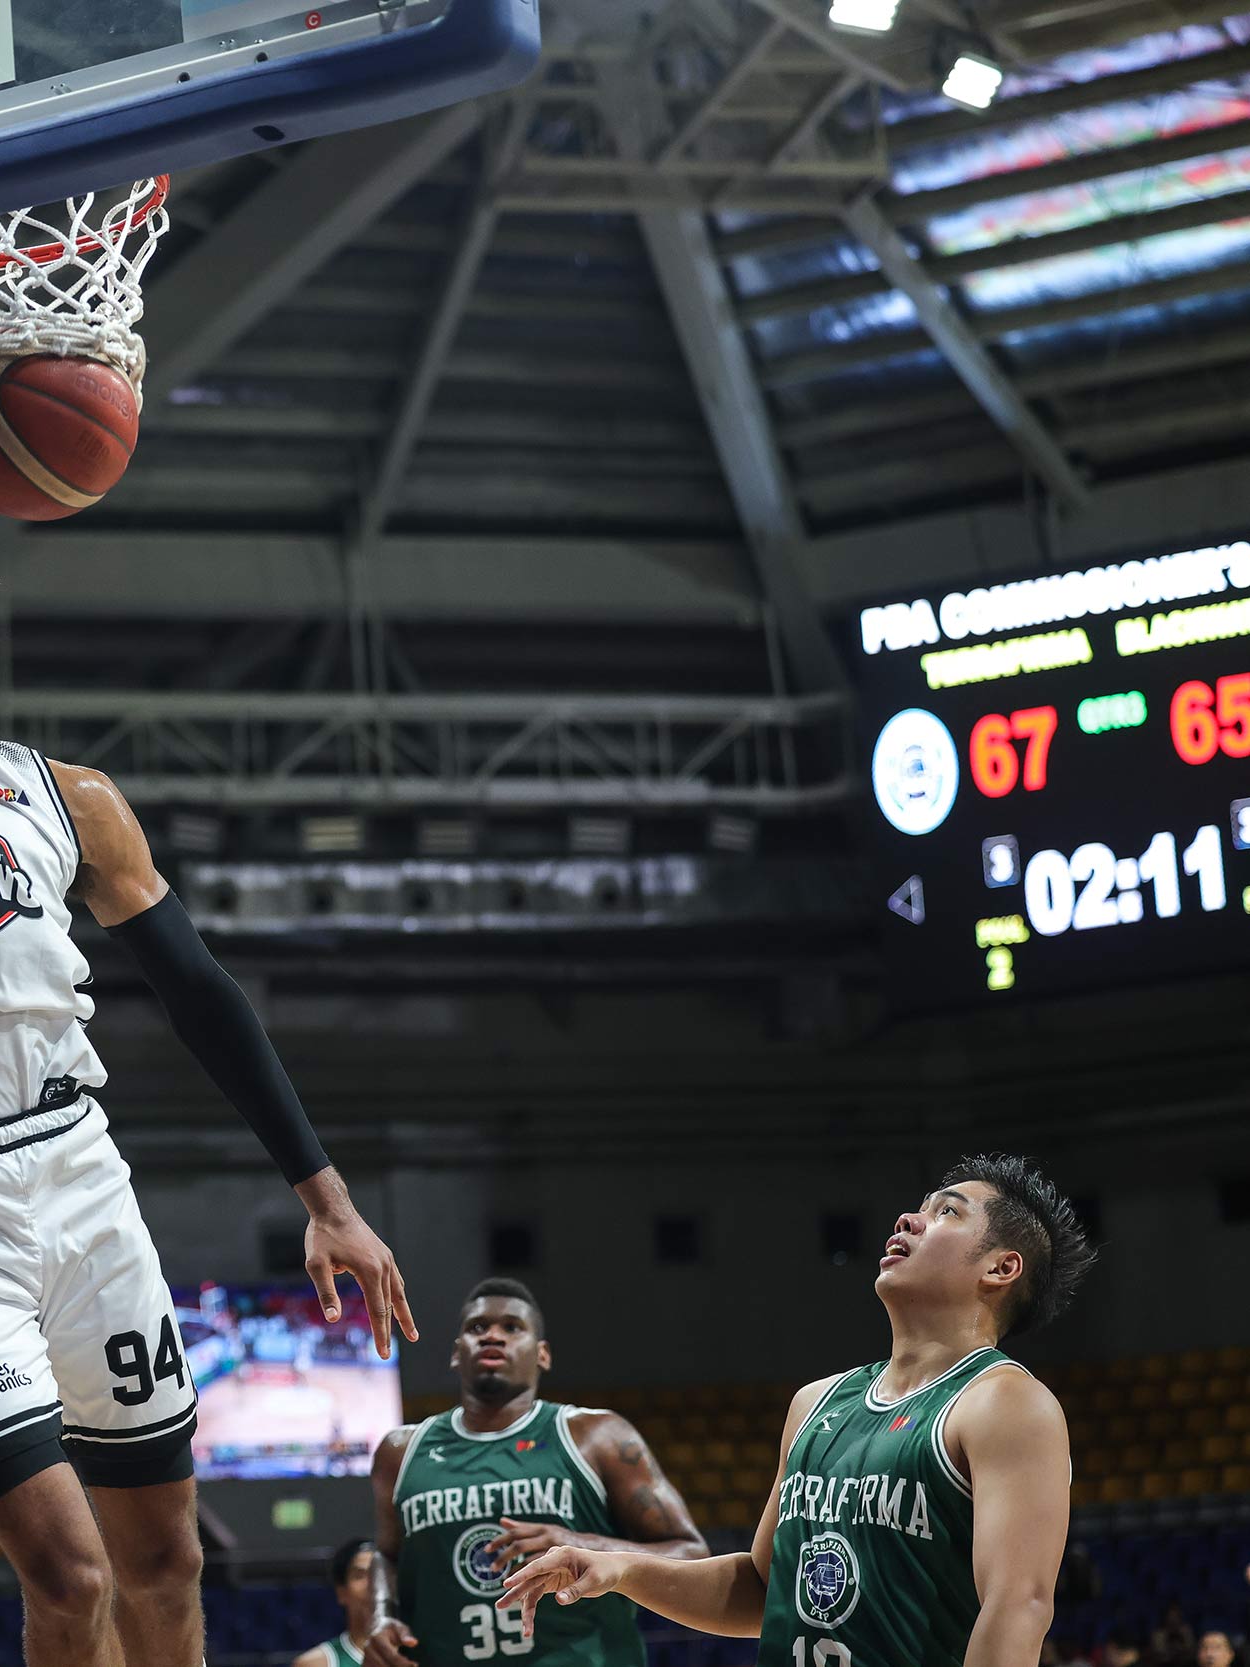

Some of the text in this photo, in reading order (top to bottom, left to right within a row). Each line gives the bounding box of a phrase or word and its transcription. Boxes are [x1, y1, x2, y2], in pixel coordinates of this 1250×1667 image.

[970, 706, 1058, 798] 67
[1170, 673, 1250, 765] 65
[1024, 824, 1227, 938] 02:11
[104, 1313, 186, 1407] 94
[777, 1470, 934, 1541] ERRAFIRMA
[460, 1602, 535, 1661] 39
